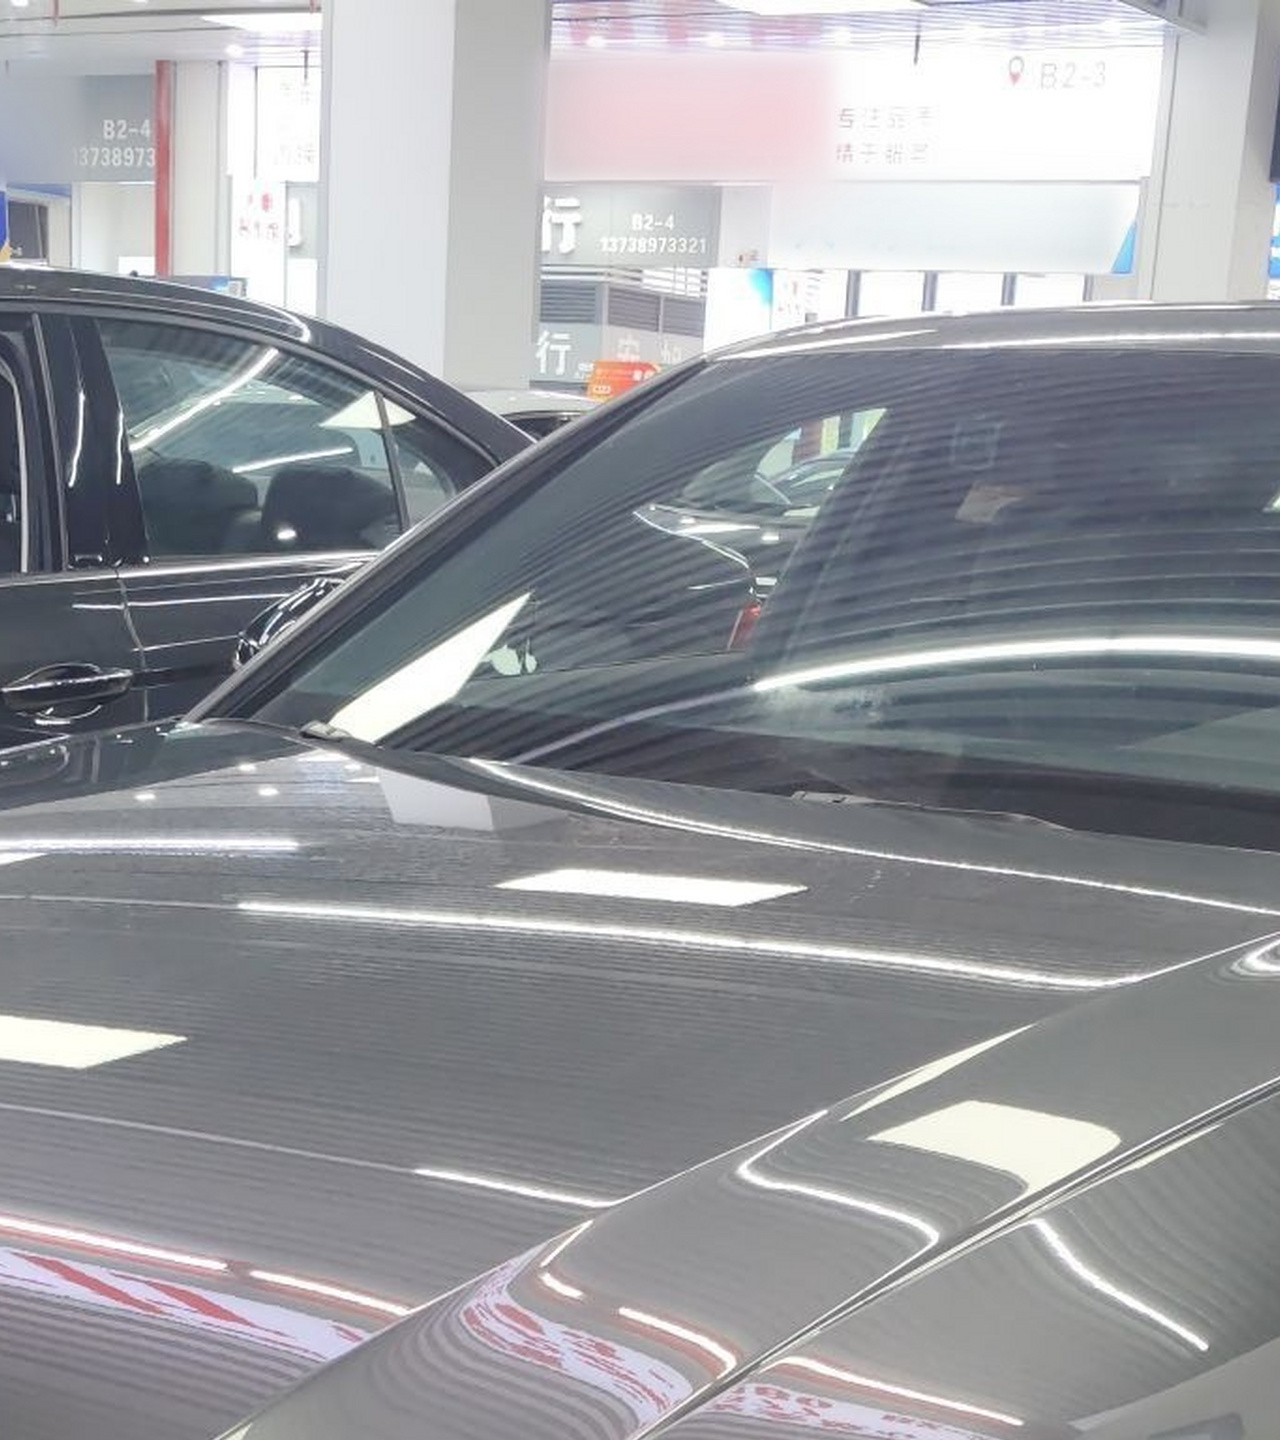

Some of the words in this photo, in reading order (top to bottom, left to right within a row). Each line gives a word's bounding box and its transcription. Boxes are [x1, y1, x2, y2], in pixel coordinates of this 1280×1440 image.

[1040, 60, 1107, 89] B2-3
[103, 119, 152, 140] B2-4
[541, 195, 582, 254] 行
[631, 213, 675, 232] B2-4
[599, 236, 708, 254] 13738973321
[535, 330, 572, 376] 行
